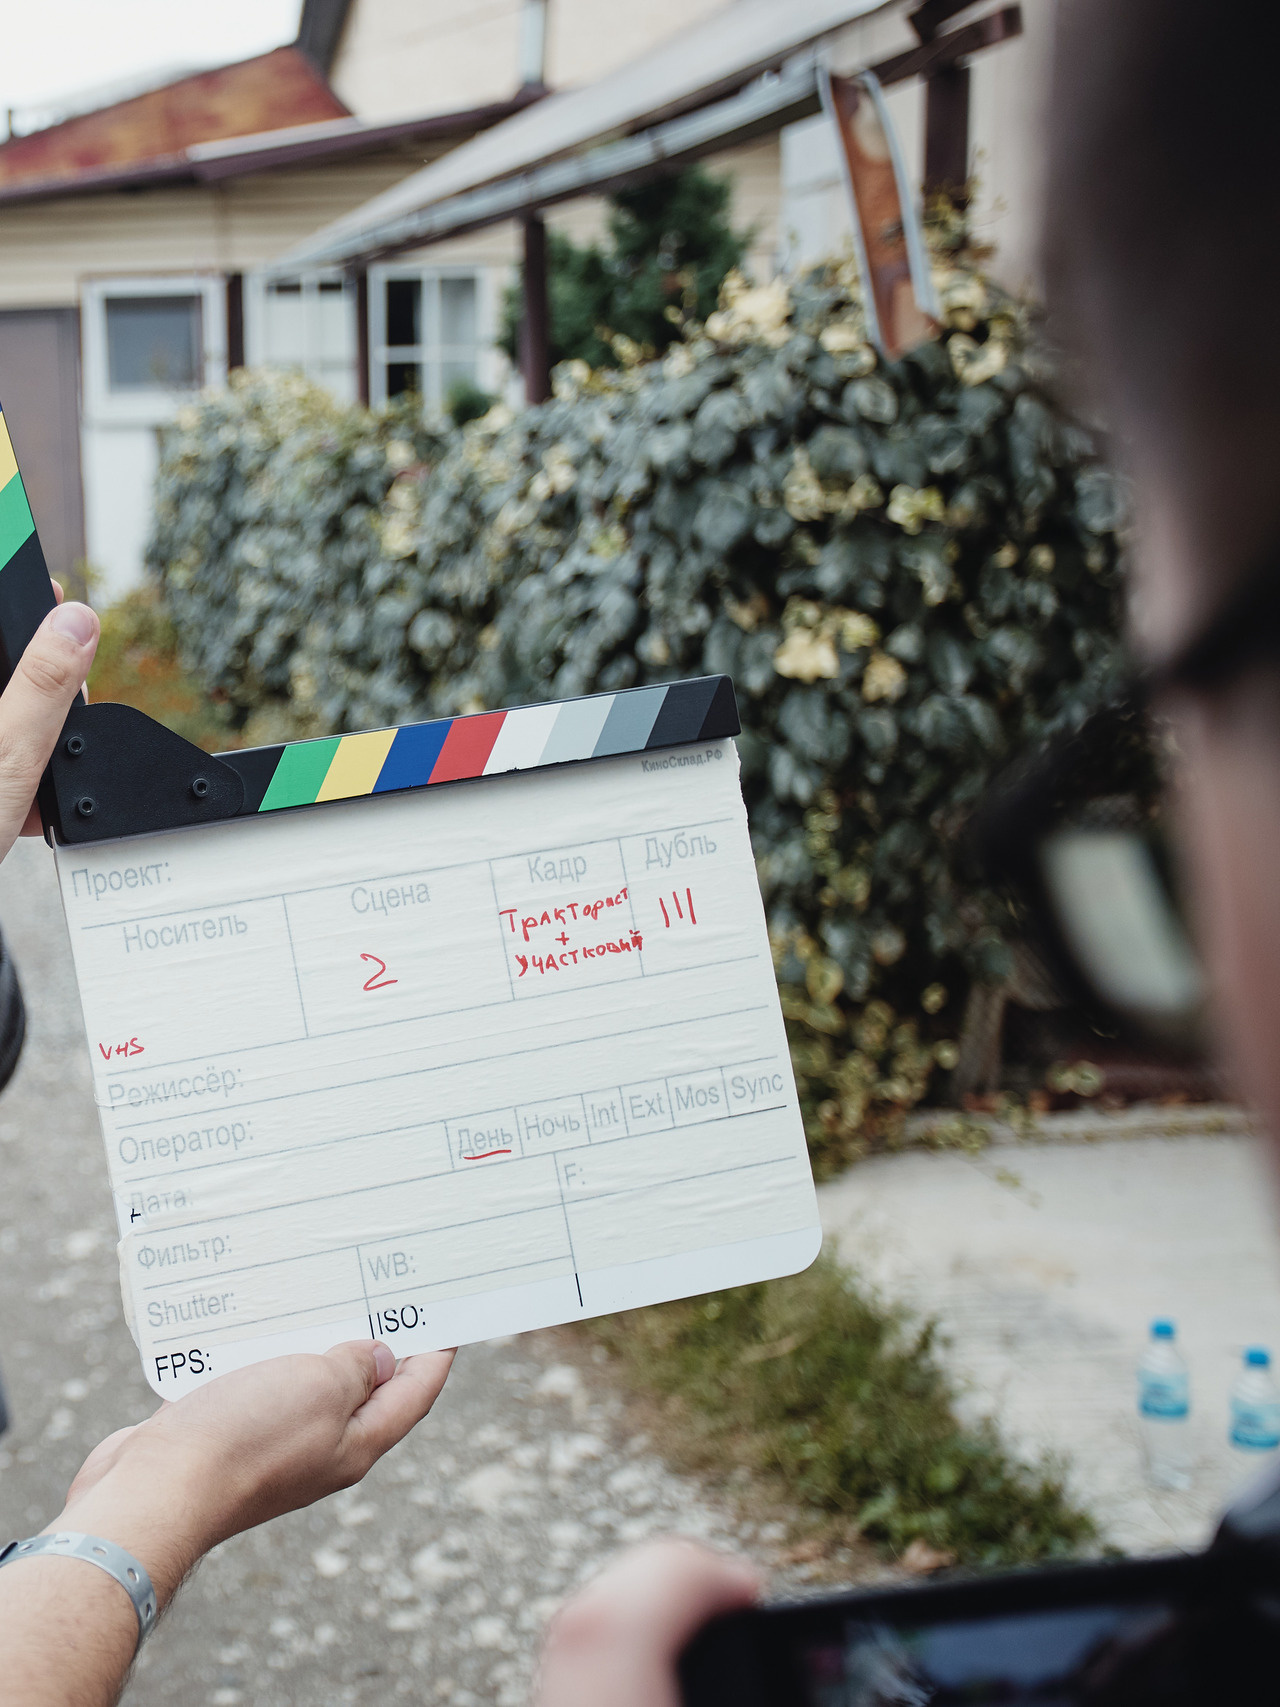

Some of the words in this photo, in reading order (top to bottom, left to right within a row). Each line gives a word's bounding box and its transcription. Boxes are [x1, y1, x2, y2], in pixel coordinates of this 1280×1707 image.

[641, 749, 724, 773] КиноСклад.РФ
[644, 831, 718, 869] Дубль
[71, 861, 172, 901] Проект:
[526, 855, 588, 884] Кадр
[350, 882, 431, 916] Сцена
[122, 914, 249, 953] Носитель
[359, 952, 399, 992] 2
[98, 1036, 146, 1061] VHS
[106, 1066, 245, 1112] Режиссёр:
[590, 1103, 620, 1129] Int
[627, 1093, 665, 1120] Ext
[674, 1084, 721, 1112] Mos
[731, 1071, 785, 1104] Sync
[117, 1119, 256, 1166] Оператор:
[456, 1124, 514, 1160] День
[522, 1112, 581, 1141] Ночь
[563, 1162, 587, 1186] F:
[136, 1233, 234, 1270] Фильтр:
[367, 1251, 418, 1282] WB:
[147, 1291, 238, 1328] Shutter:
[376, 1304, 427, 1336] ISO:
[154, 1348, 214, 1382] FPS:
